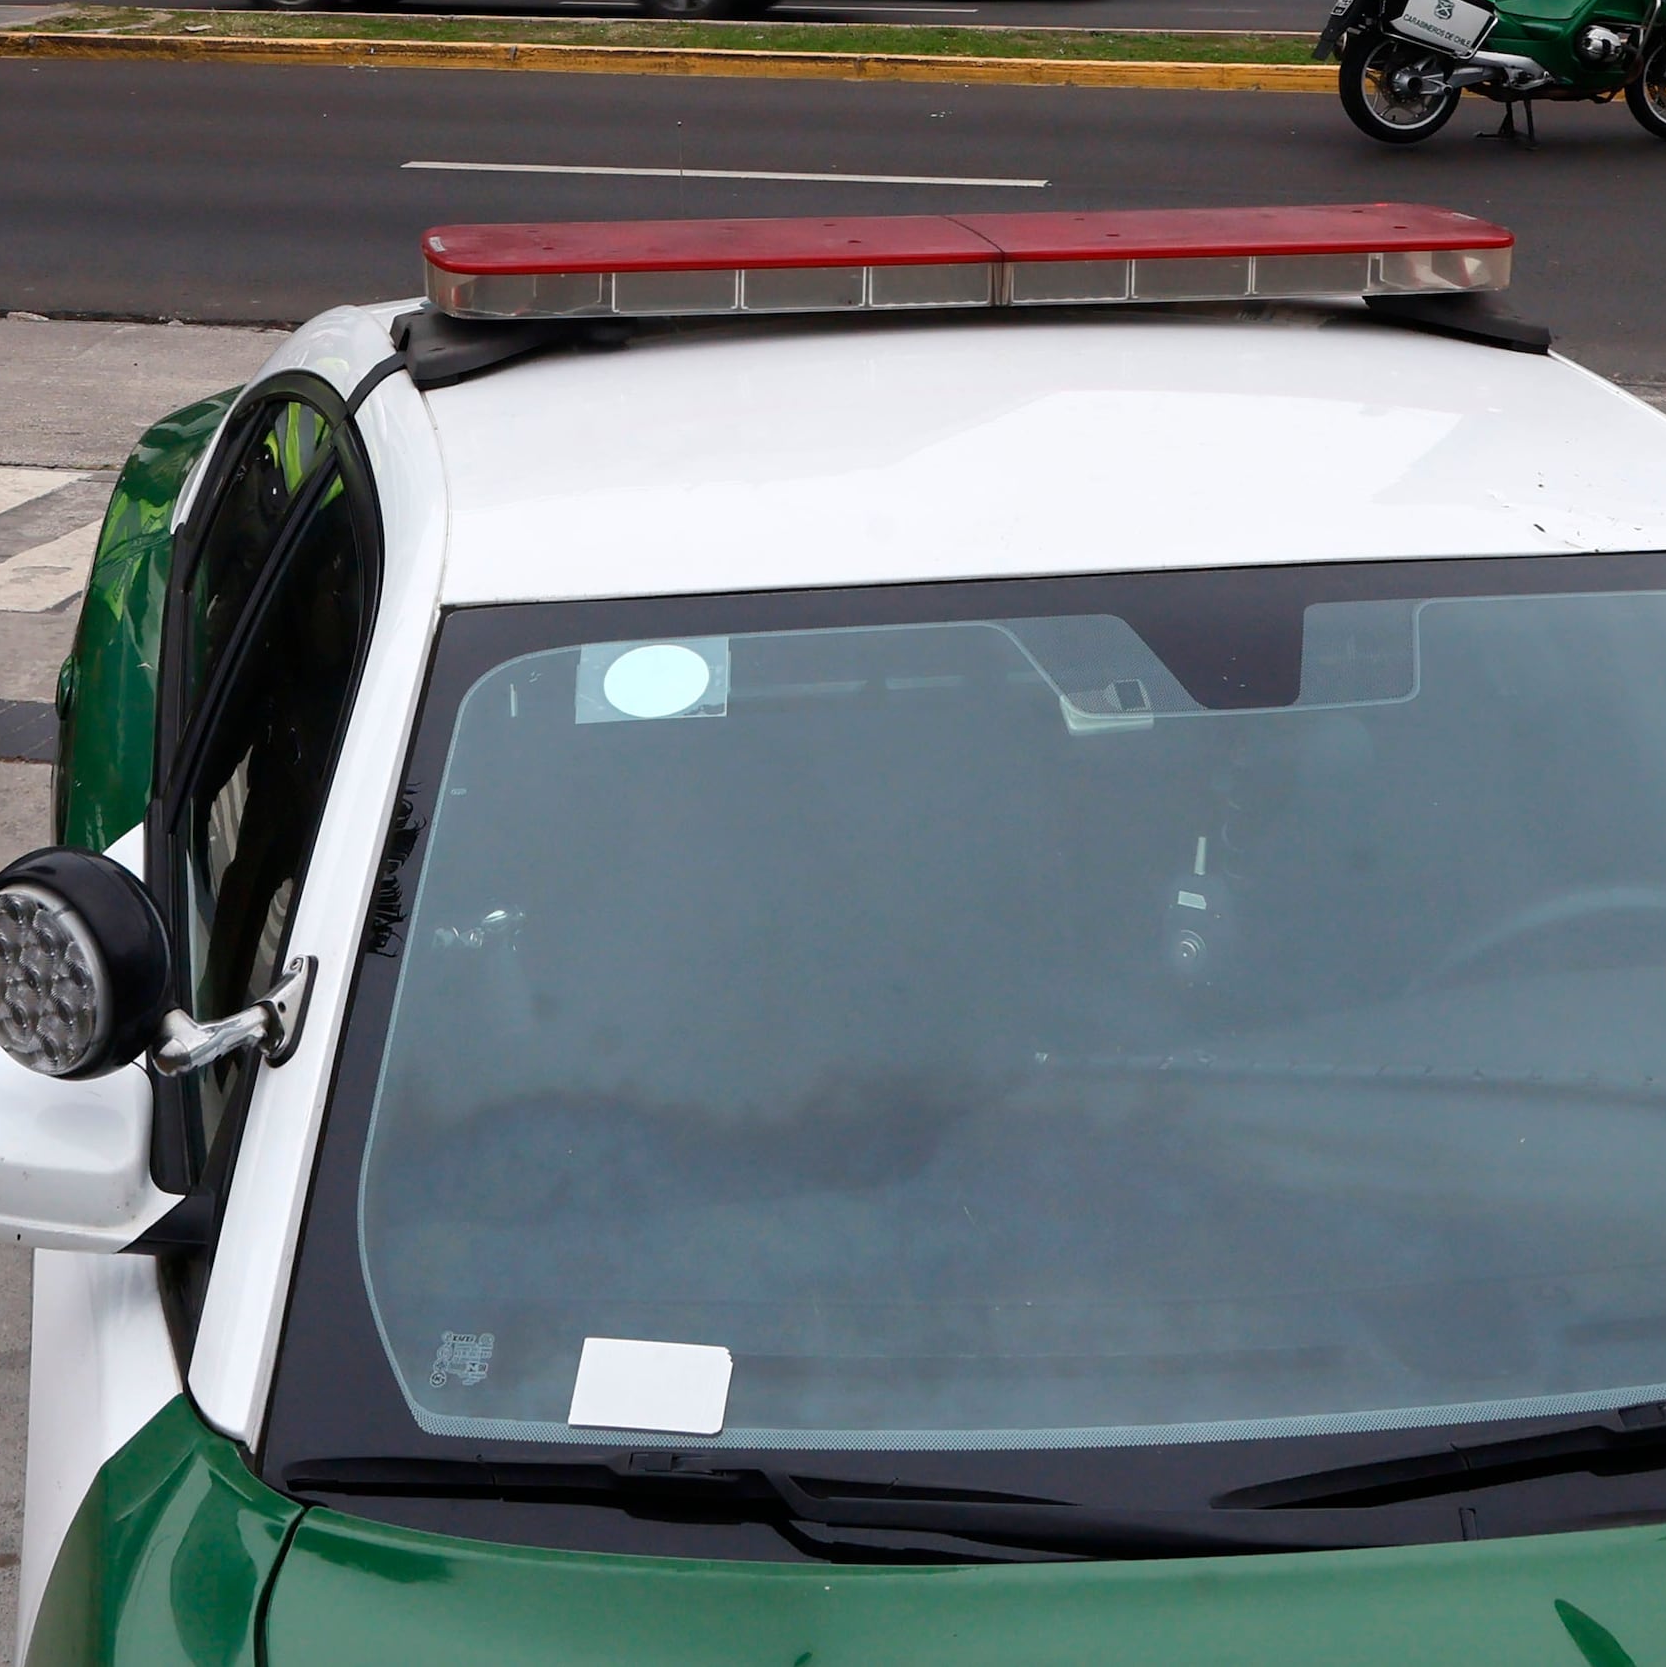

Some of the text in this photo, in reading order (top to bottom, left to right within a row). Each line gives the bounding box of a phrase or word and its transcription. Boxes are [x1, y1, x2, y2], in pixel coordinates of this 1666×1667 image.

[1403, 14, 1471, 48] CARABINEROS DE CHILE
